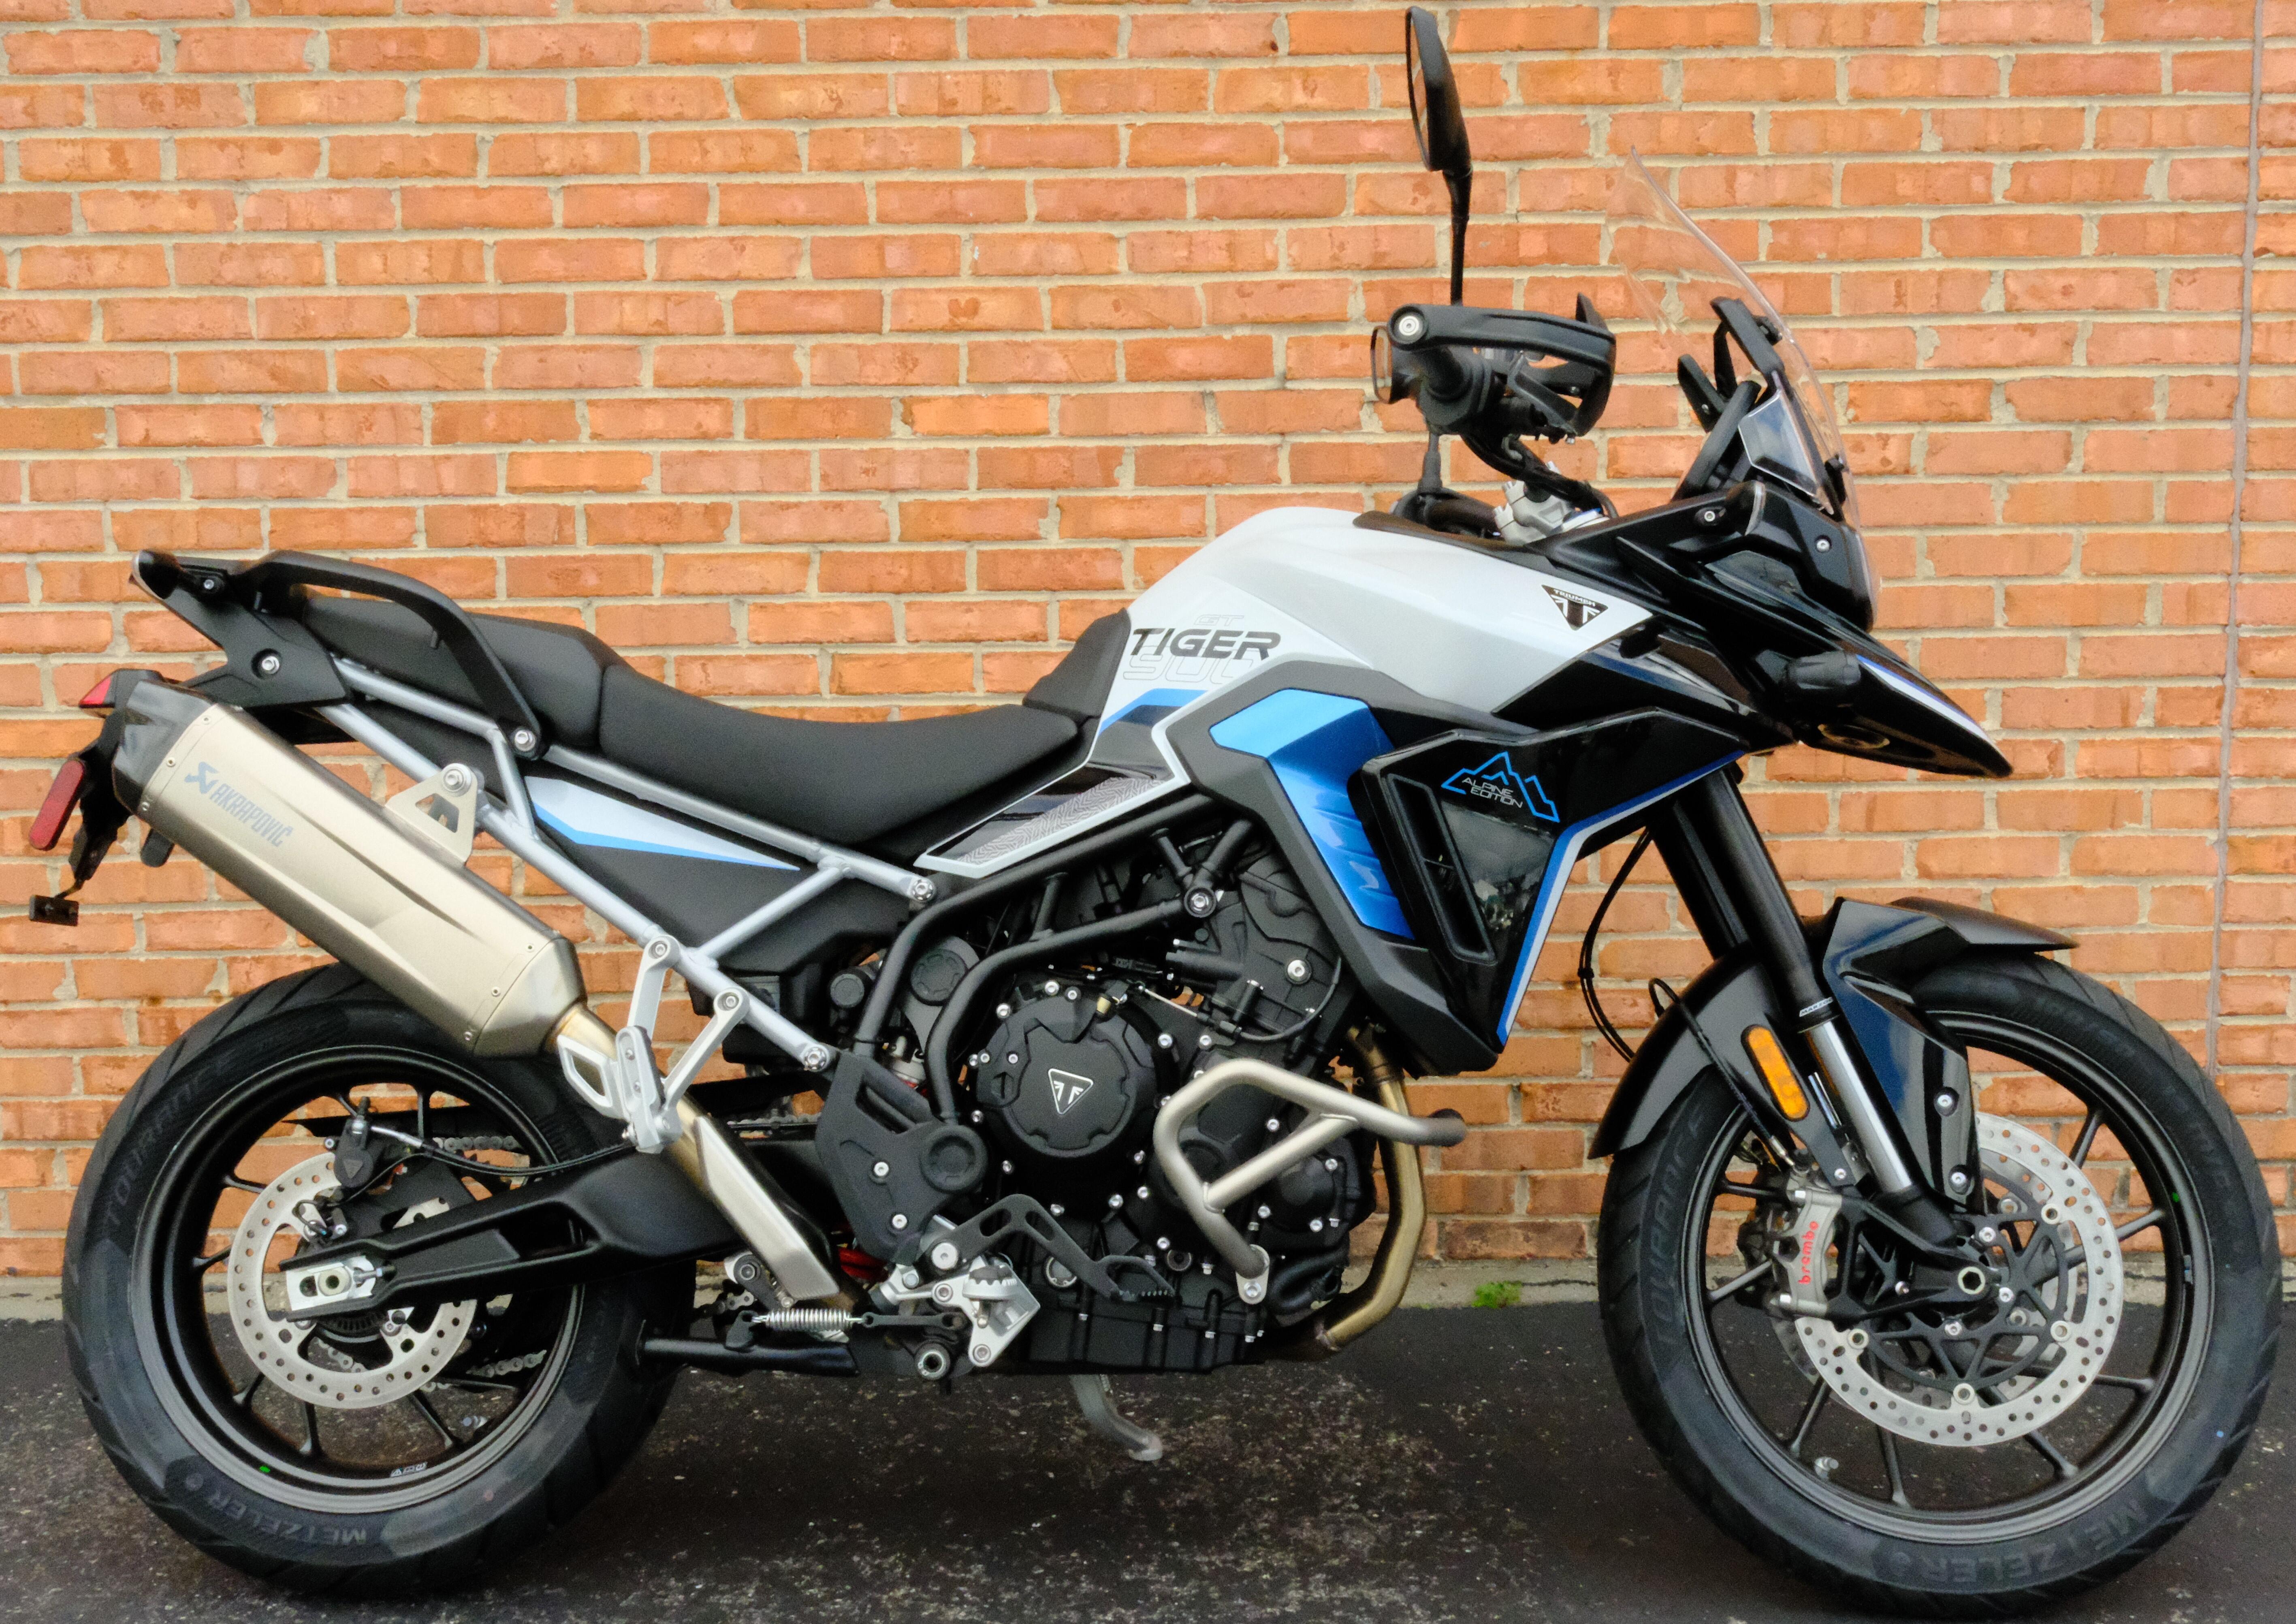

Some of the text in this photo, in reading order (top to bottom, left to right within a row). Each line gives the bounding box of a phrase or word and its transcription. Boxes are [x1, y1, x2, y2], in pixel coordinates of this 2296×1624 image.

[1553, 589, 1596, 607] TRIUMPH
[1194, 614, 1244, 626] GT
[1131, 628, 1282, 660] TIGER
[1462, 777, 1514, 798] ALPINE
[1470, 786, 1523, 808] EDITION
[1798, 1220, 1819, 1284] brembo
[205, 1489, 367, 1545] METZELER
[1921, 1498, 2148, 1581] METZELER
